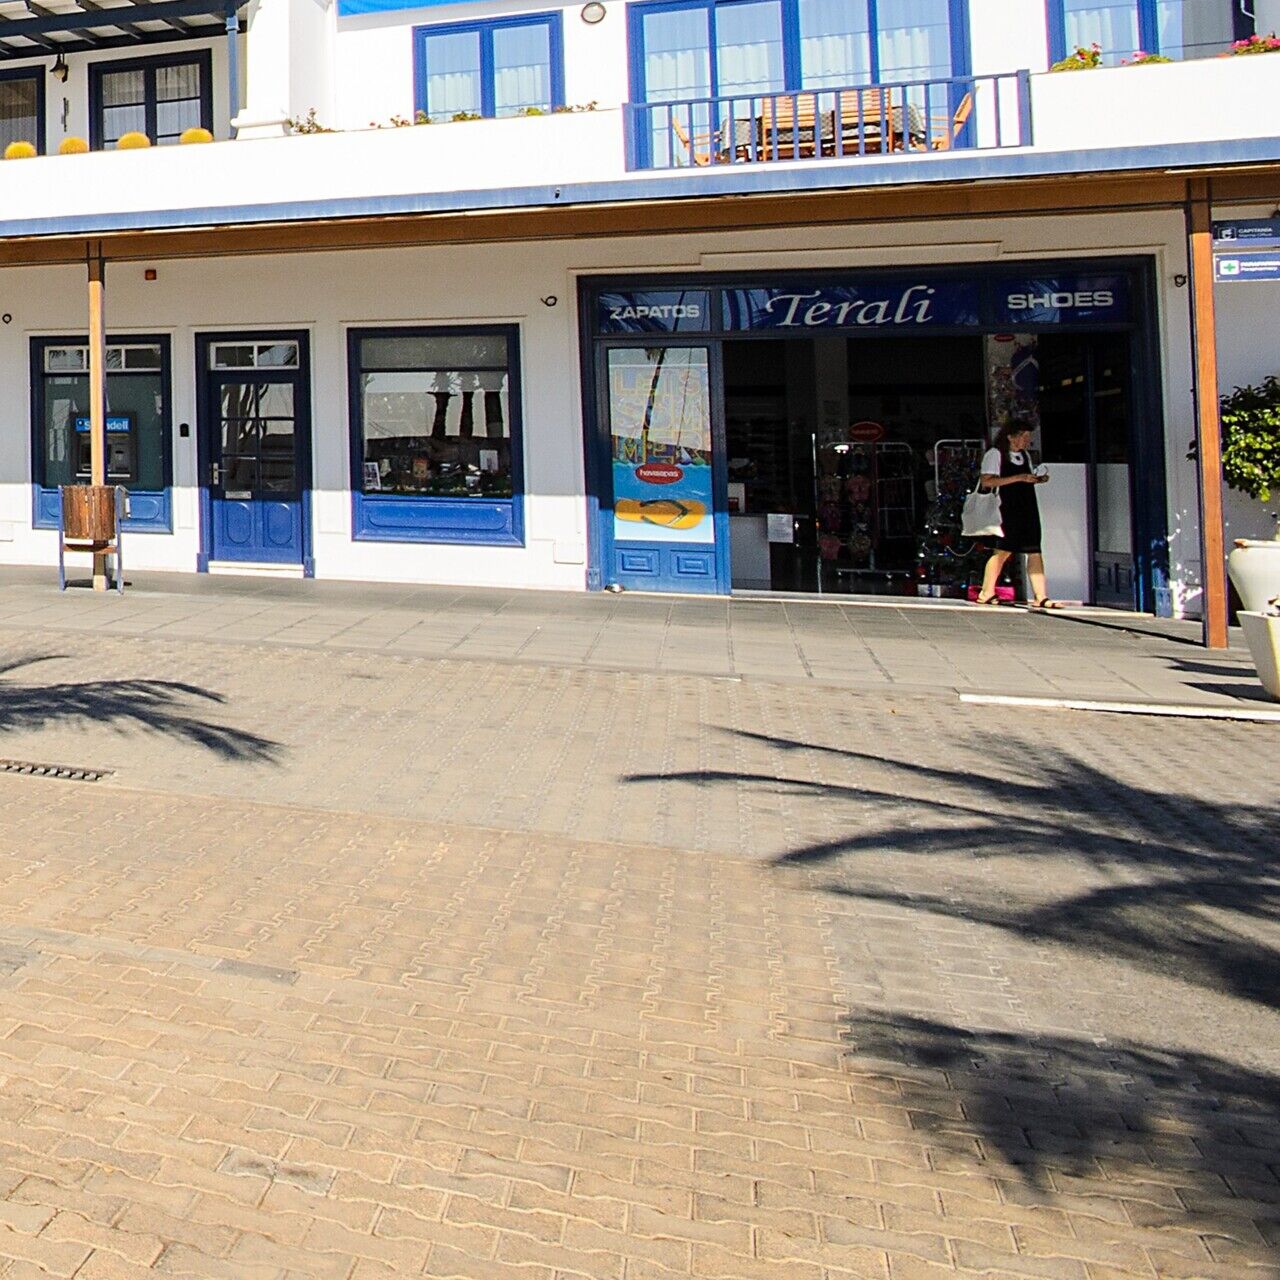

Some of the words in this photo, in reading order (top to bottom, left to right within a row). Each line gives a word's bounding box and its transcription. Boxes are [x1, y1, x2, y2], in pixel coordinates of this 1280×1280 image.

[766, 285, 934, 327] Terali
[1007, 291, 1114, 310] SHOES
[609, 305, 700, 320] ZAPATOS
[84, 420, 129, 431] Sadell
